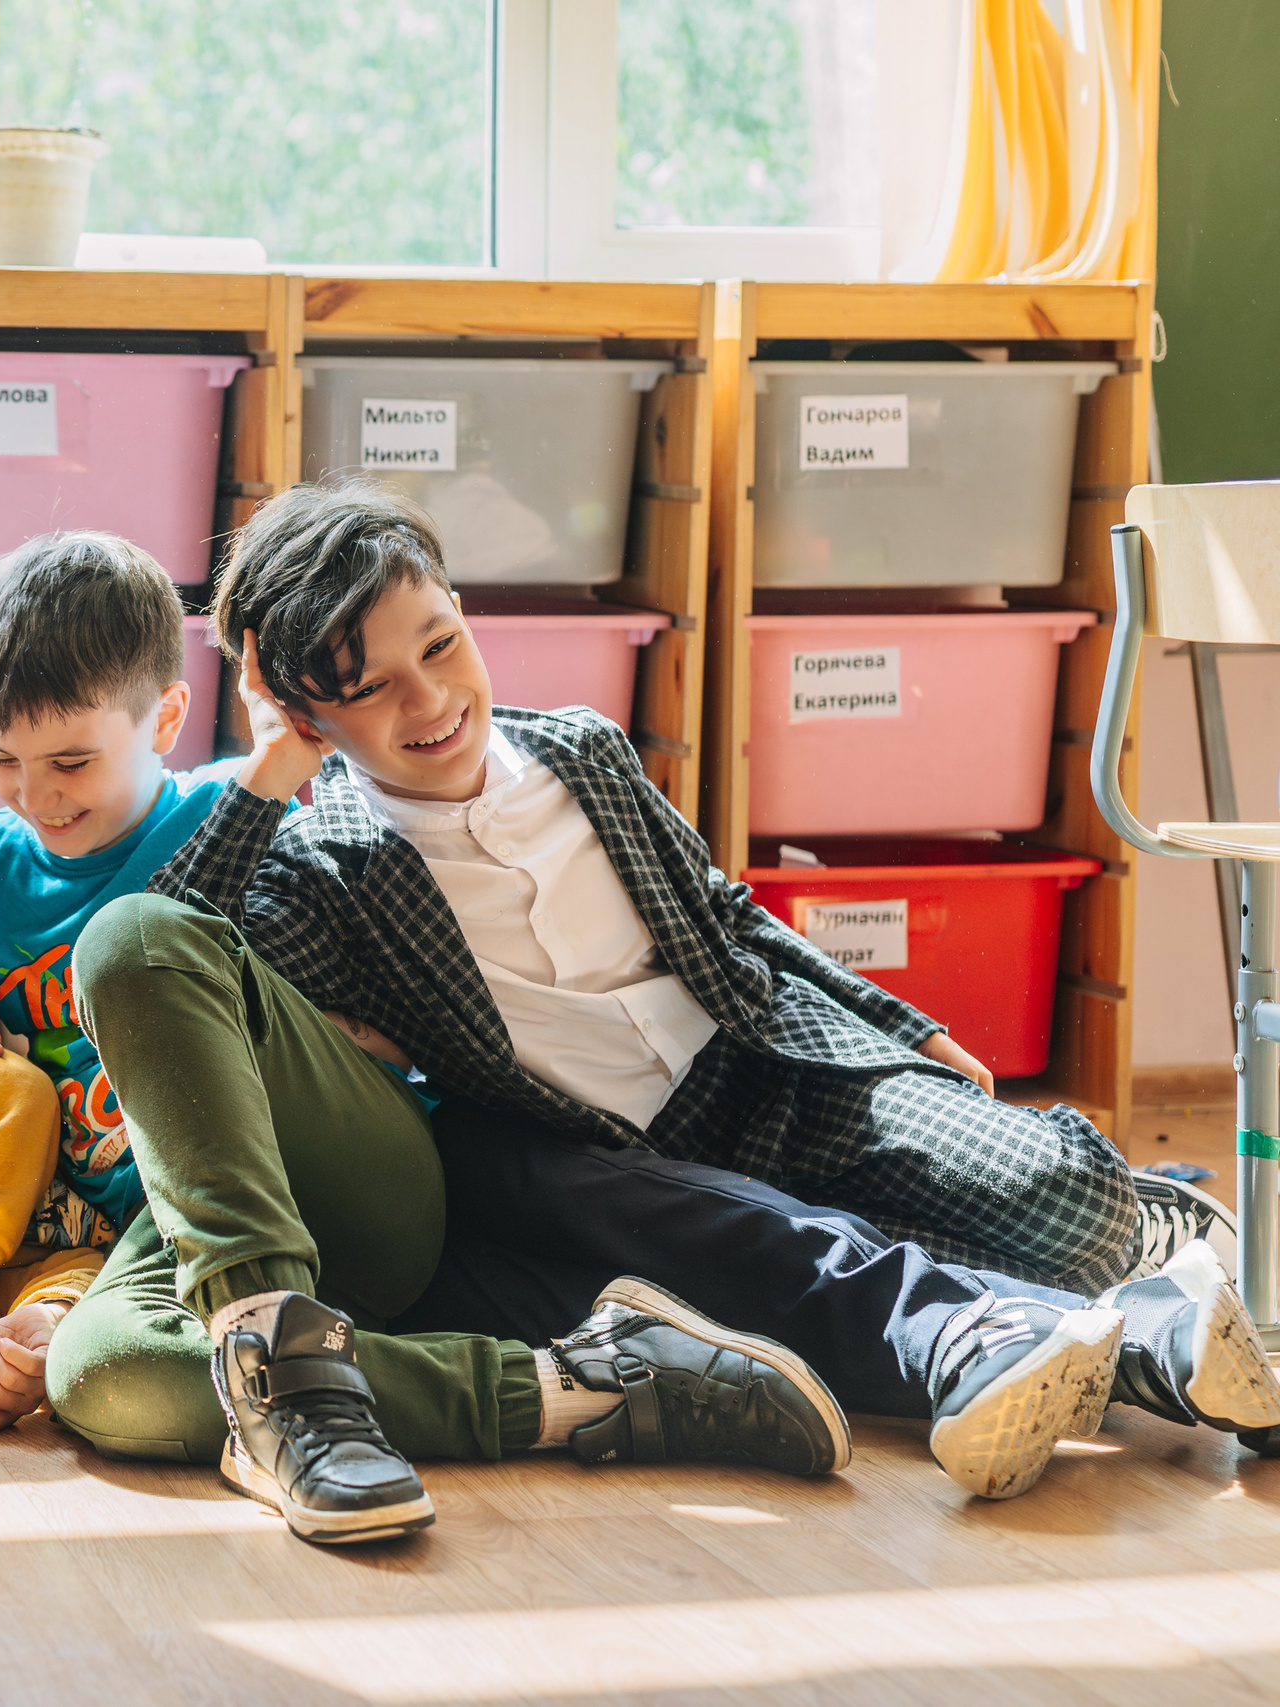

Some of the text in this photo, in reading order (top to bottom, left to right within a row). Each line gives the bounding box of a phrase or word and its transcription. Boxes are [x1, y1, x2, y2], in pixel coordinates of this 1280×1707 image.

[365, 407, 447, 424] Мильто
[806, 406, 902, 427] Гончаров
[364, 446, 439, 463] Никита
[806, 445, 874, 465] Вадим
[794, 655, 886, 675] Горячева
[794, 692, 898, 713] Екатерина
[811, 907, 904, 930] Зурначян
[823, 949, 875, 965] грат
